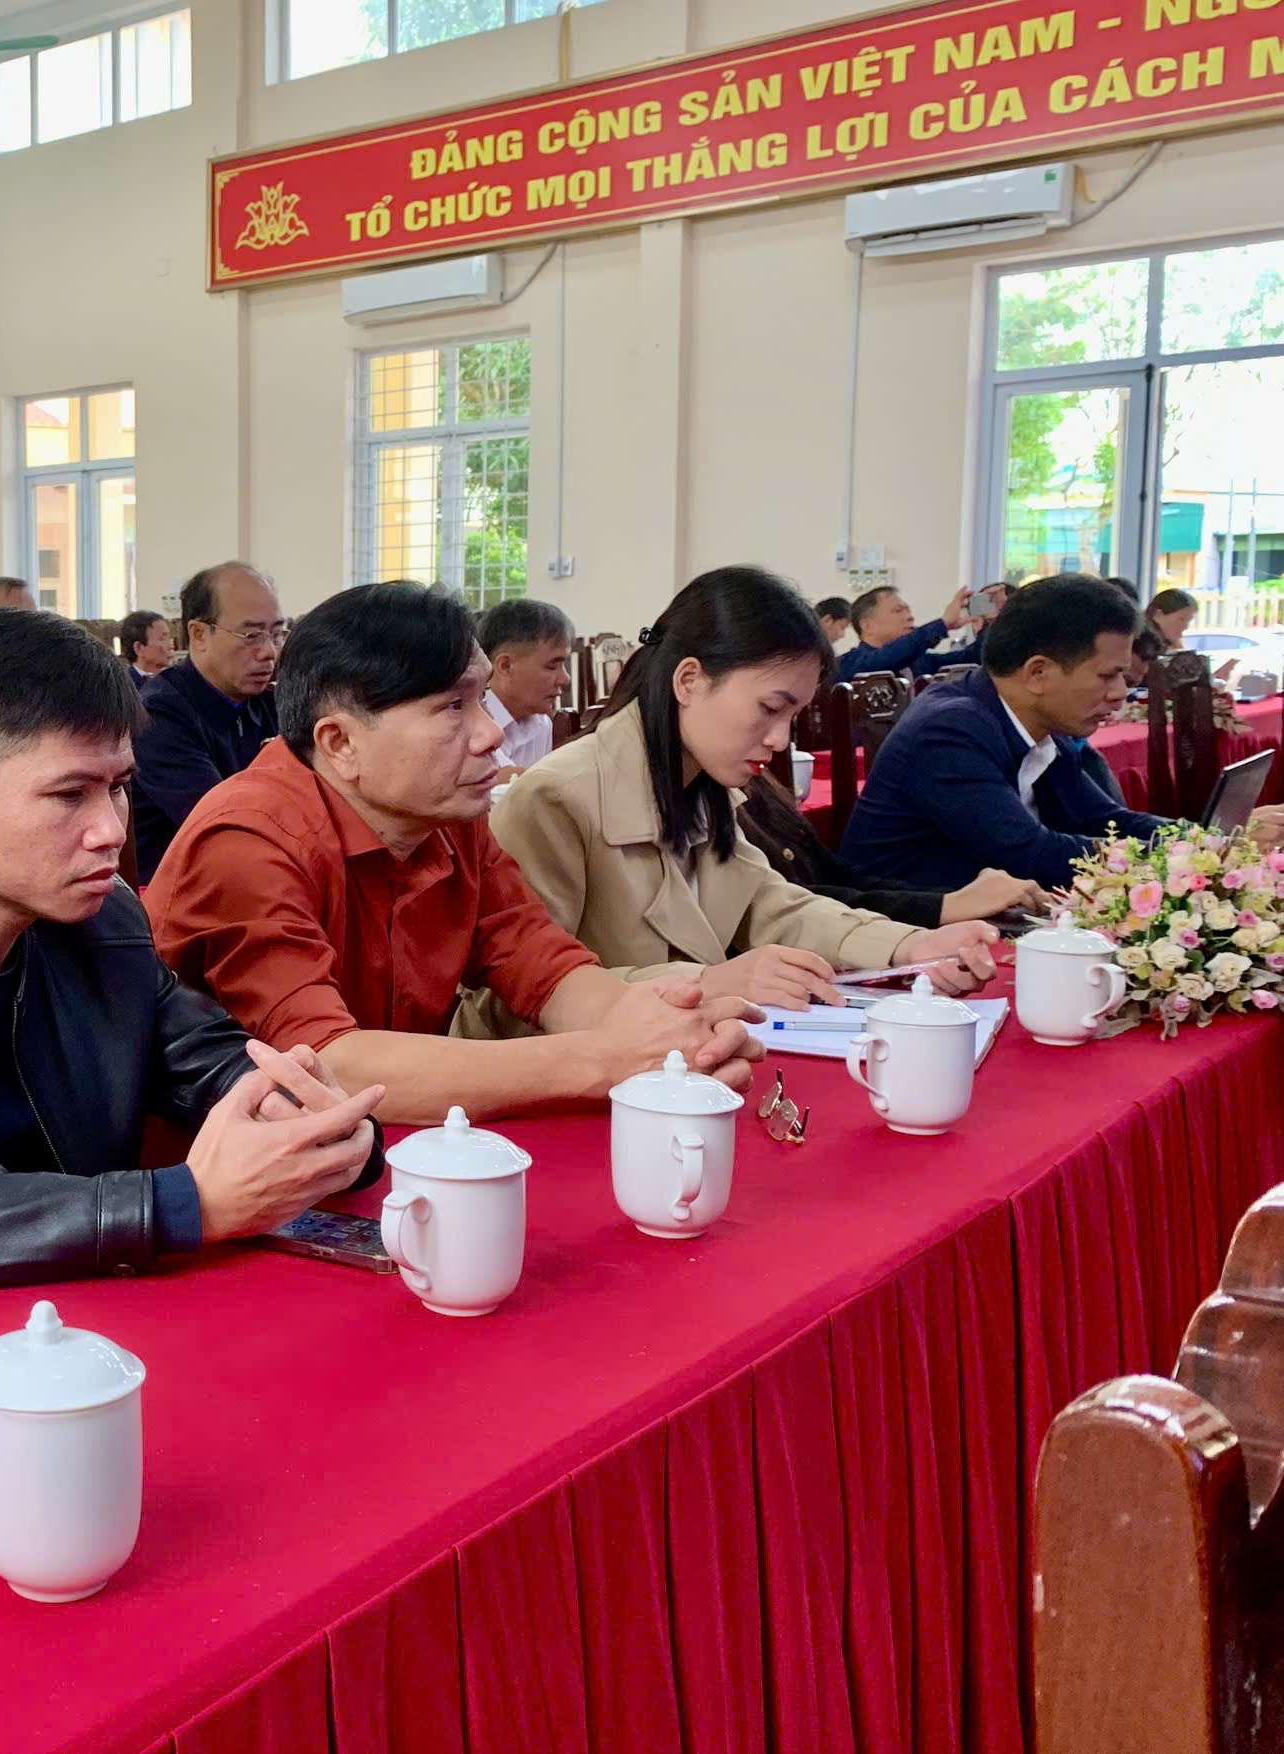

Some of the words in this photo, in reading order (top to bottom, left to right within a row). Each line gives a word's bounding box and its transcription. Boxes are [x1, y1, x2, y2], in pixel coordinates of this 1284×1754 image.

[345, 195, 393, 241] TỔ
[403, 182, 512, 231] CHỨC
[526, 166, 612, 211] MỌI
[626, 133, 788, 192] THẮNG
[806, 112, 889, 161] LỢI
[908, 80, 1028, 140] CỦA
[1048, 47, 1225, 114] CÁCH
[410, 130, 523, 180] ĐẢNG
[538, 101, 662, 154] CỘNG
[678, 70, 782, 126] SẢN
[799, 45, 916, 101] VIỆT
[934, 10, 1076, 75] NAM
